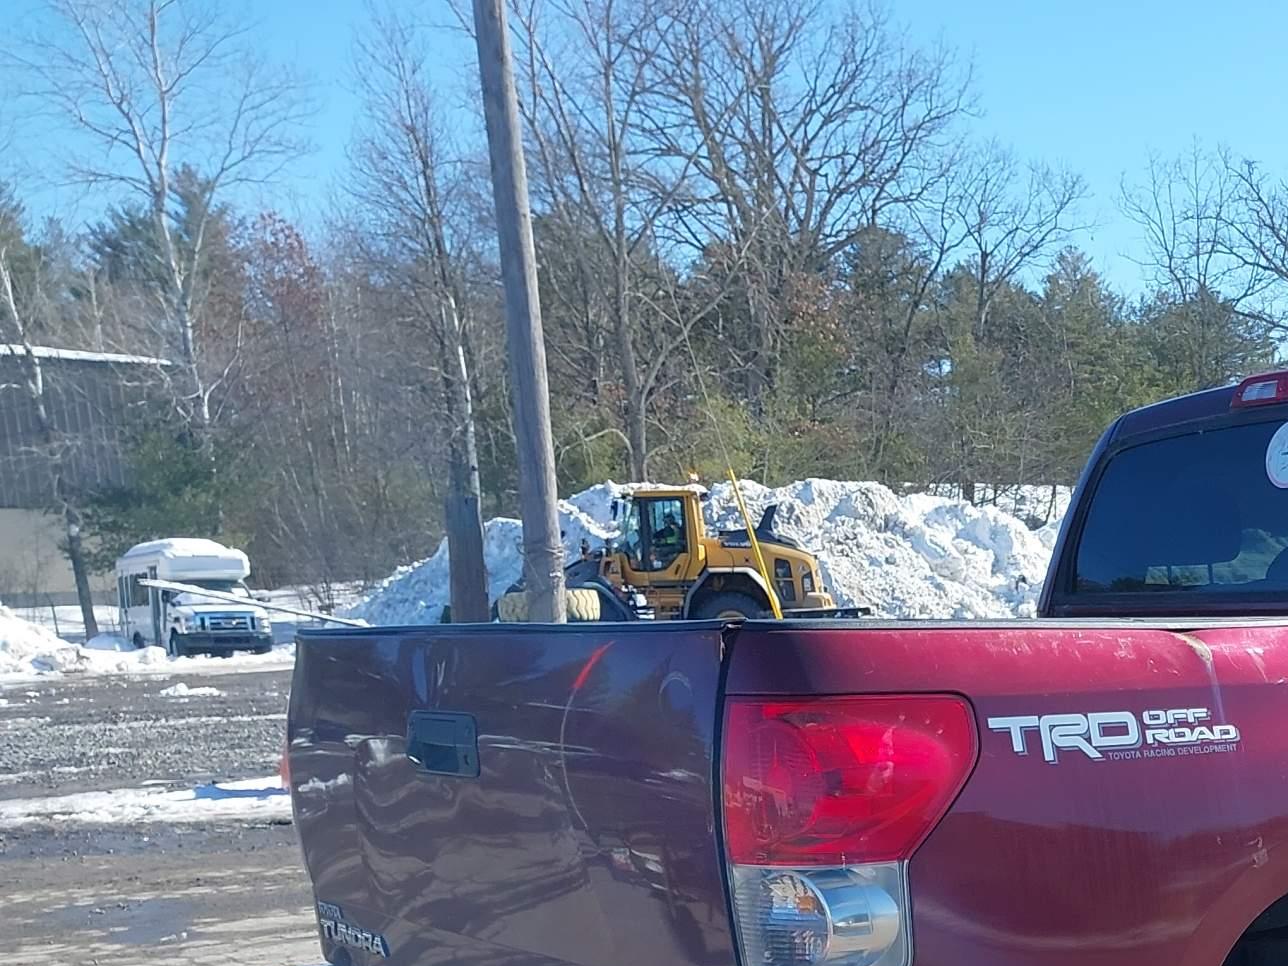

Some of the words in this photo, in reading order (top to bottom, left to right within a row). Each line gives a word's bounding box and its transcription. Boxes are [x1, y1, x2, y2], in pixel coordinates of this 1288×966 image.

[1142, 708, 1210, 727] OFF
[988, 711, 1142, 764] TRD
[1145, 725, 1239, 745] ROAD
[1108, 751, 1142, 761] TOYOTA
[1143, 748, 1176, 758] RACING
[1178, 743, 1238, 756] DEVELOPMENT
[319, 918, 386, 958] TUNDRA
